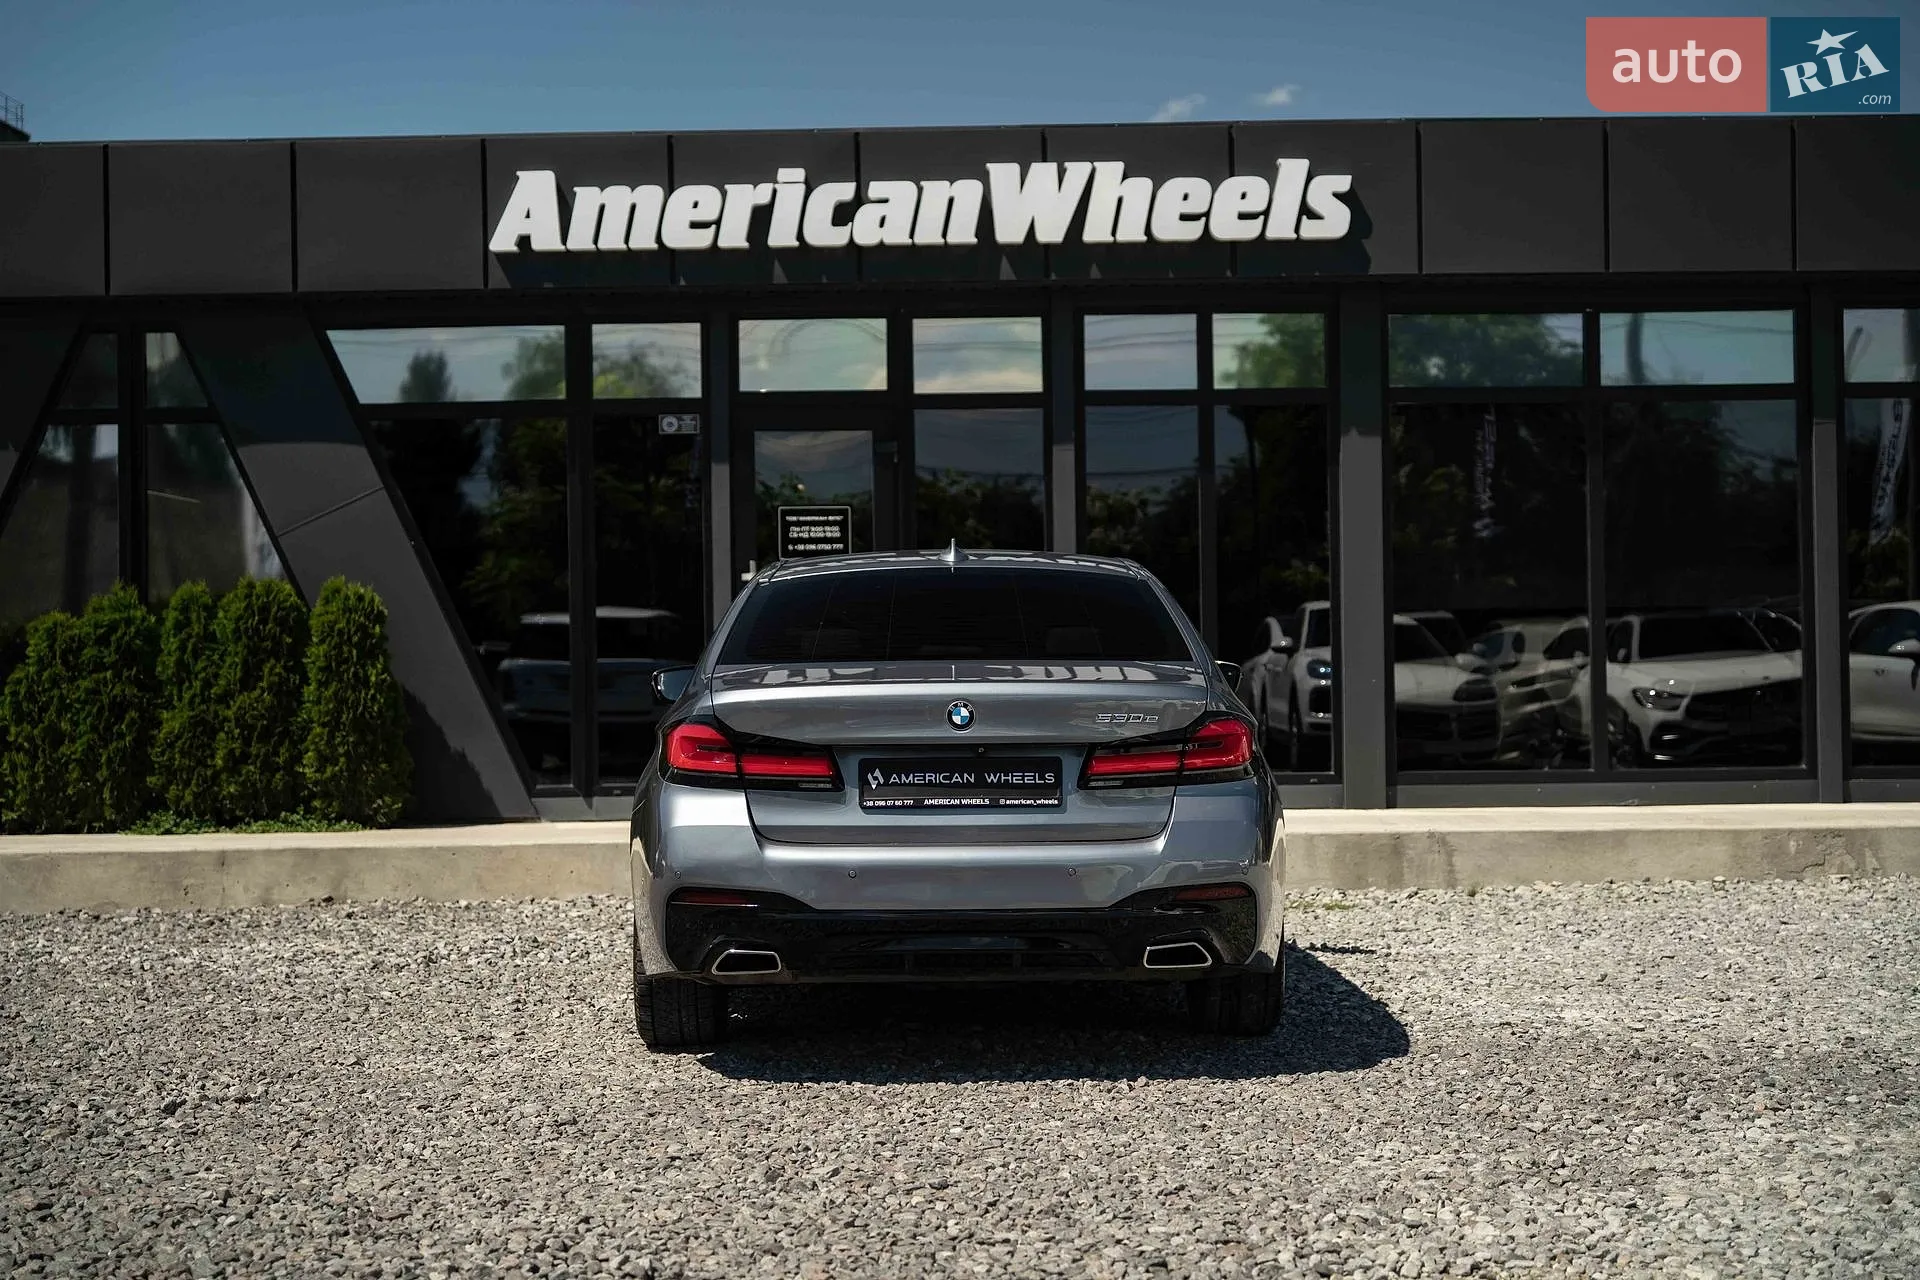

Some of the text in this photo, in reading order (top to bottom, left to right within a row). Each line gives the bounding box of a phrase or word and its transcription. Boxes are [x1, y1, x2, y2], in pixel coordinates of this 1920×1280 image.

[489, 158, 1353, 252] AmericanWheels
[1096, 713, 1159, 722] 530e
[889, 772, 1055, 784] AMERICAN WHEELS
